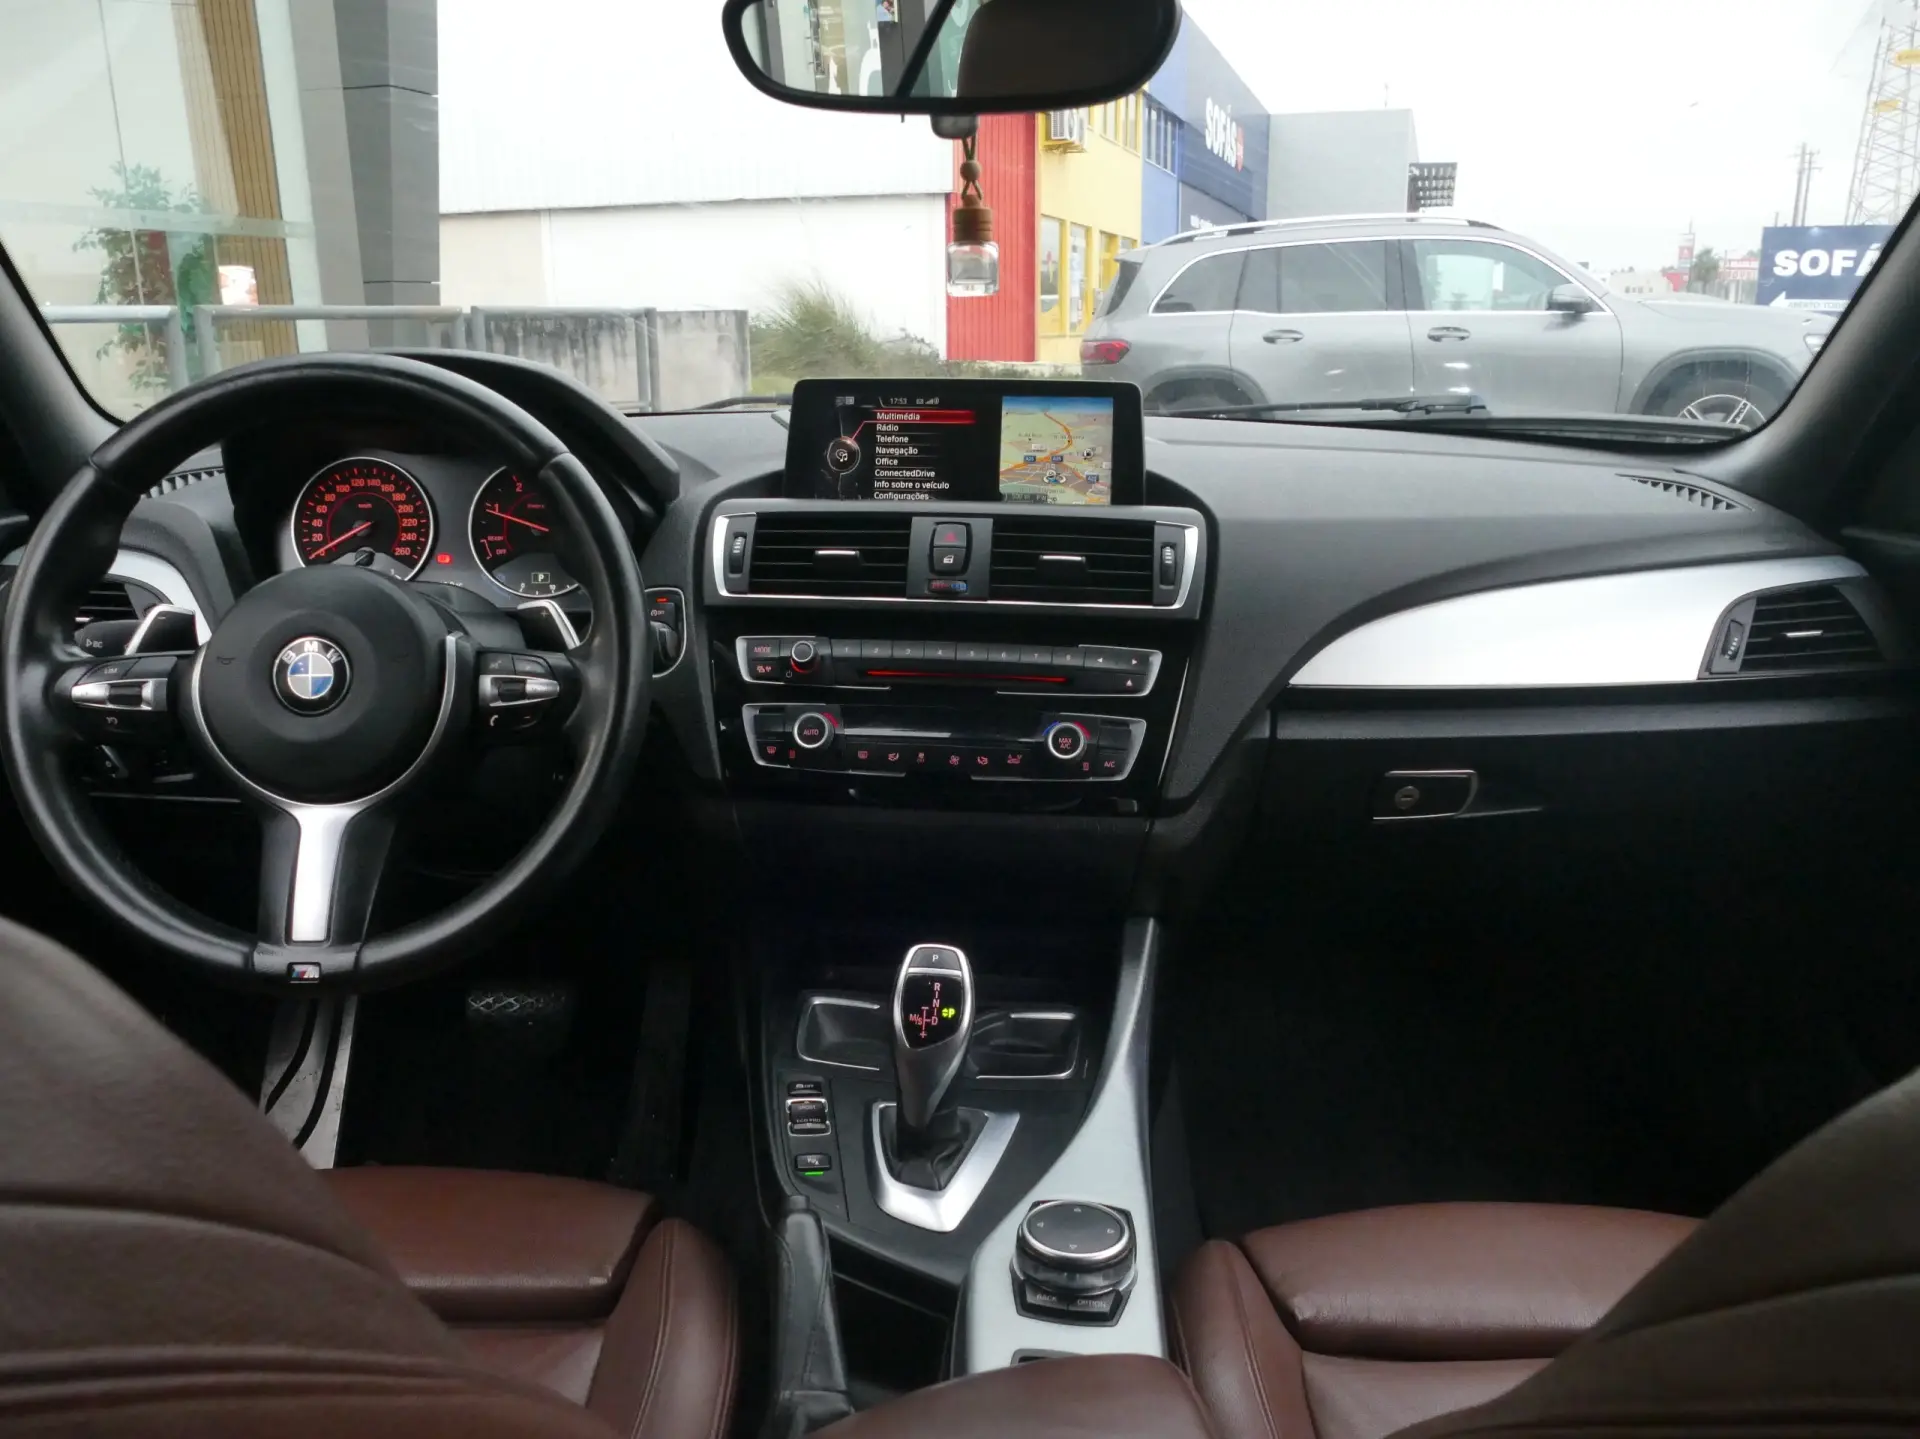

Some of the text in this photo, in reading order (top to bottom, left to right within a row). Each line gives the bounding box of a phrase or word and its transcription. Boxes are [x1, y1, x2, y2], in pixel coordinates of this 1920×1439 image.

[890, 397, 907, 405] 17:53
[876, 412, 920, 420] Multimédia
[876, 423, 899, 431] Rádio
[876, 434, 909, 443] Telefone
[875, 446, 918, 456] Navegação
[875, 457, 898, 466] Office
[874, 468, 936, 478] ConnectedDrive
[351, 478, 365, 487] 120
[367, 479, 381, 487] 140
[874, 480, 890, 488] Info
[891, 480, 913, 489] sobre
[922, 481, 950, 489] veículo
[336, 484, 350, 493] 100
[381, 484, 395, 492] 160
[324, 493, 336, 501] 80
[391, 493, 406, 501] 180
[873, 491, 929, 500] Configurações
[316, 505, 328, 513] 60
[398, 505, 414, 513] 200
[312, 519, 323, 527] 40
[402, 519, 418, 527] 220
[312, 533, 323, 541] 20
[401, 533, 417, 541] 240
[394, 547, 411, 556] 260
[281, 640, 342, 665] BMW
[803, 728, 819, 736] AUTO
[1104, 760, 1115, 768] A/C
[934, 982, 941, 991] R
[932, 999, 940, 1007] N
[931, 1016, 938, 1025] D
[1036, 1293, 1057, 1301] BACK
[1077, 1299, 1107, 1309] OPTION
